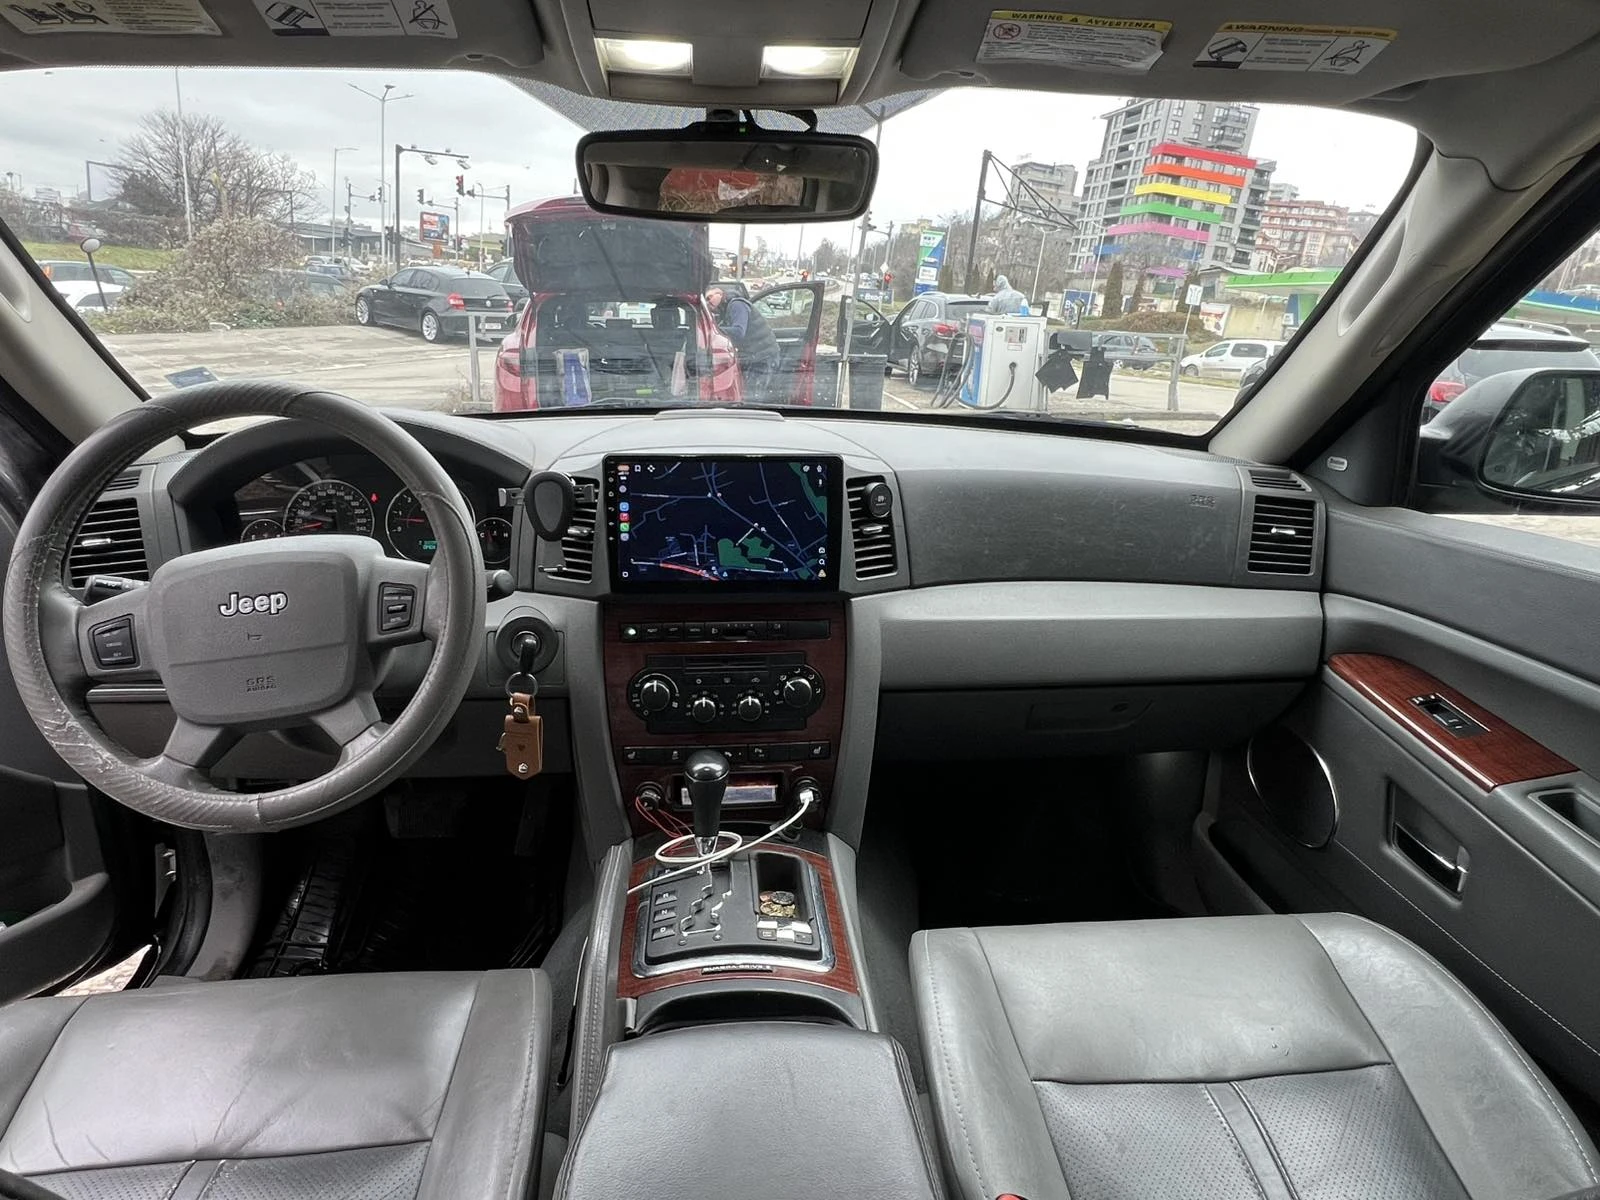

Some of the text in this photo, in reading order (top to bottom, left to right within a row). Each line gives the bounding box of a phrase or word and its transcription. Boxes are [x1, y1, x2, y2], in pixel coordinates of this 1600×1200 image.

[1011, 12, 1156, 29] WARNING AVVERTENZA
[1234, 23, 1305, 33] WARNING
[219, 592, 288, 617] Jeep
